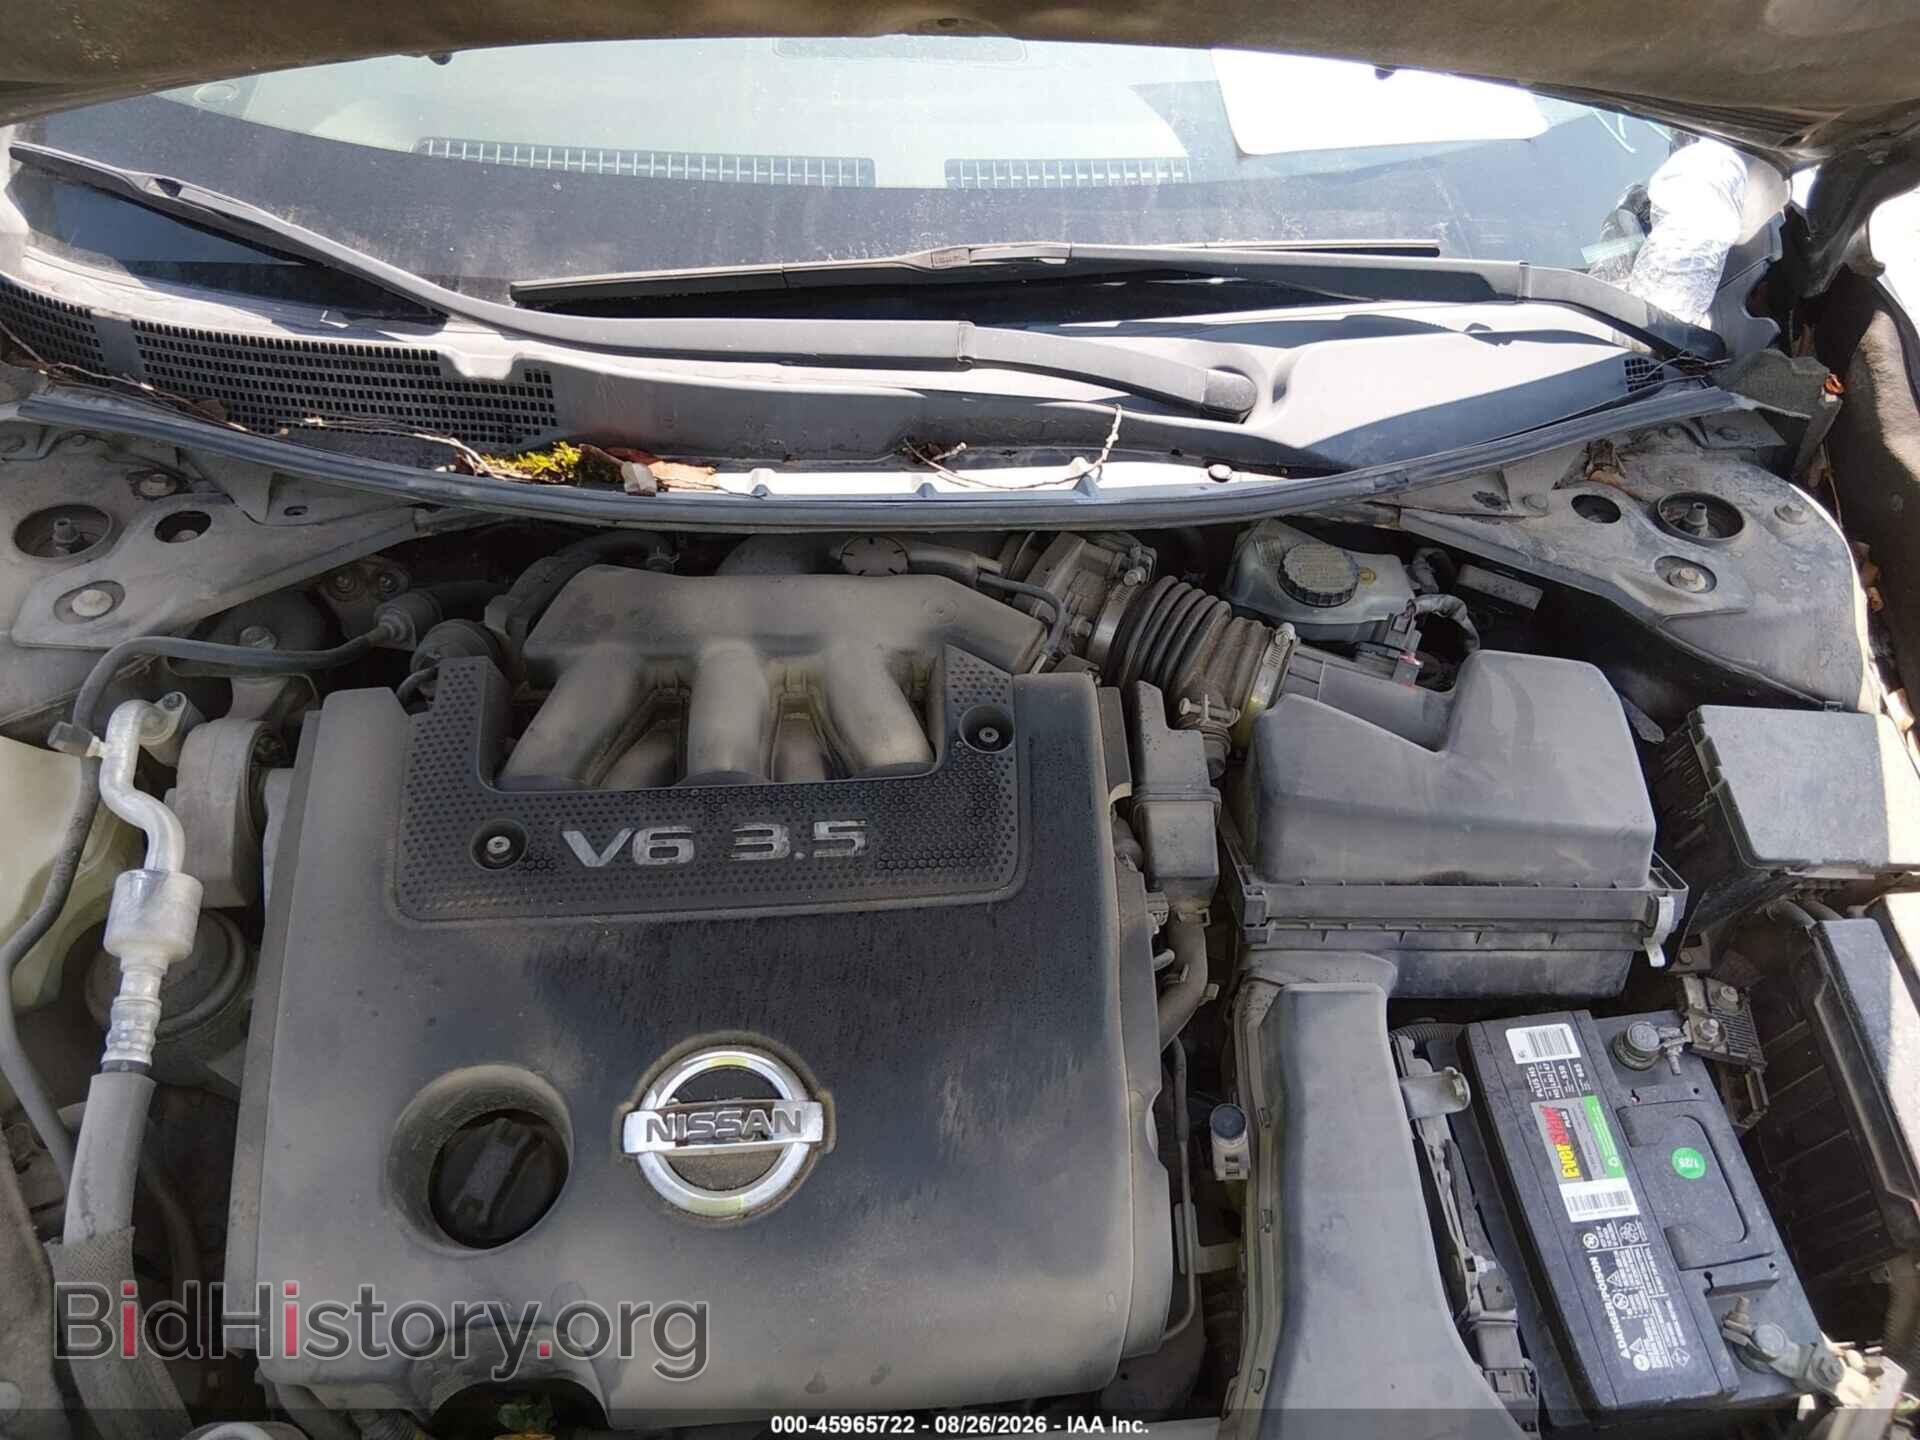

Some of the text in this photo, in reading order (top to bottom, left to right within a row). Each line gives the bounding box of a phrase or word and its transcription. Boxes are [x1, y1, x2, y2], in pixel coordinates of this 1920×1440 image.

[562, 820, 869, 867] V6 3.5
[1531, 1078, 1545, 1098] PLUS
[646, 1109, 801, 1143] NISSAN
